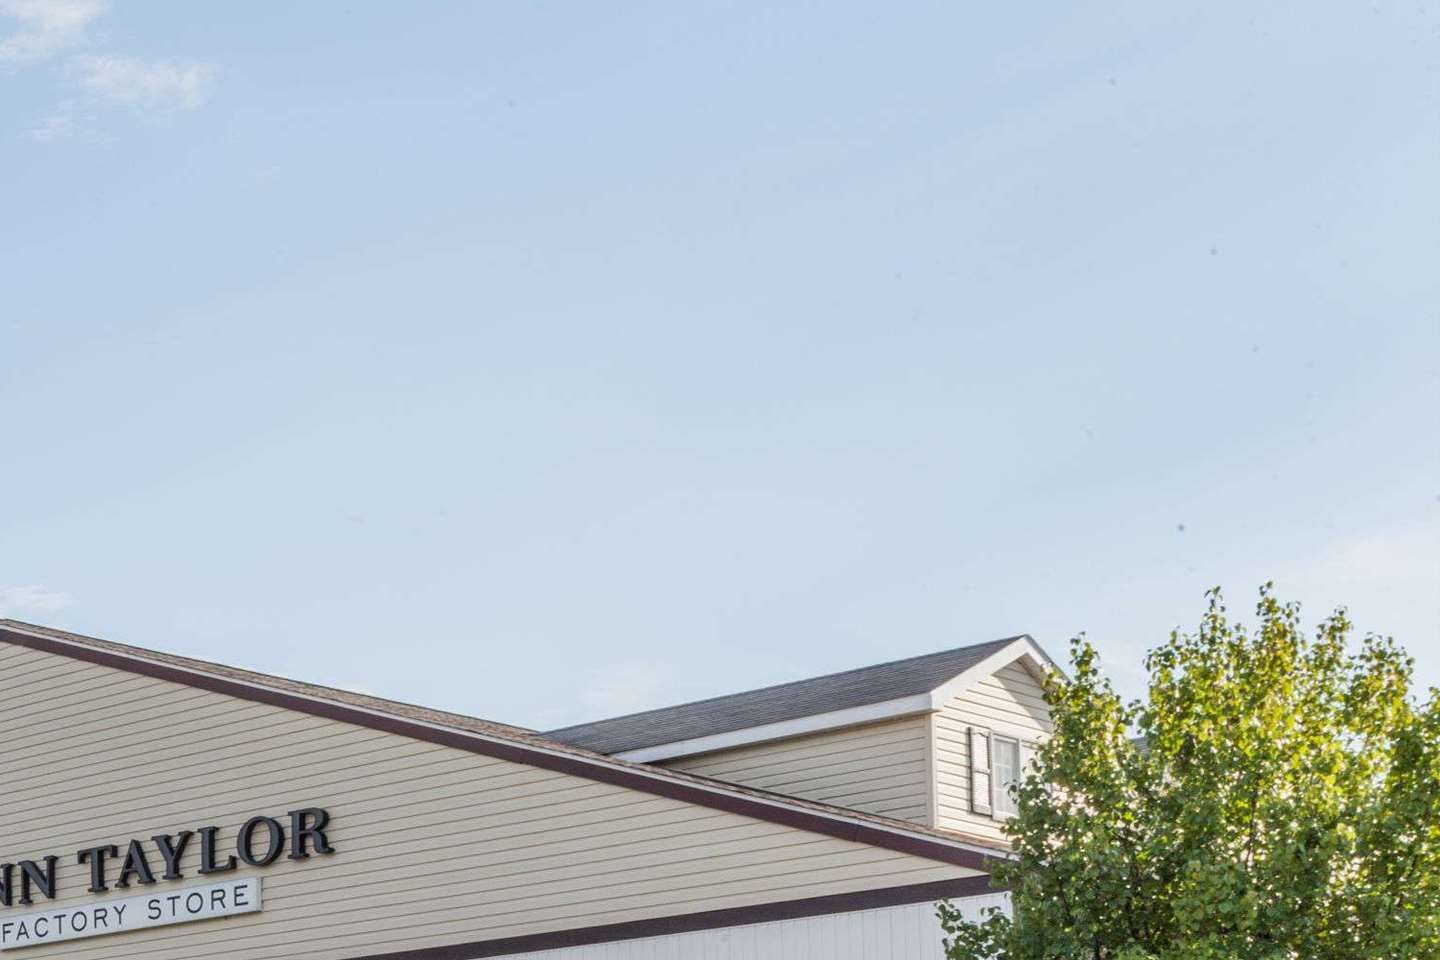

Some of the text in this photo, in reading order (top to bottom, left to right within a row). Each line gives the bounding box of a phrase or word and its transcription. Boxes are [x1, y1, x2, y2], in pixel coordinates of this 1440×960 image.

[77, 807, 336, 894] TAYLOR
[2, 884, 249, 943] FACTORY STORE
